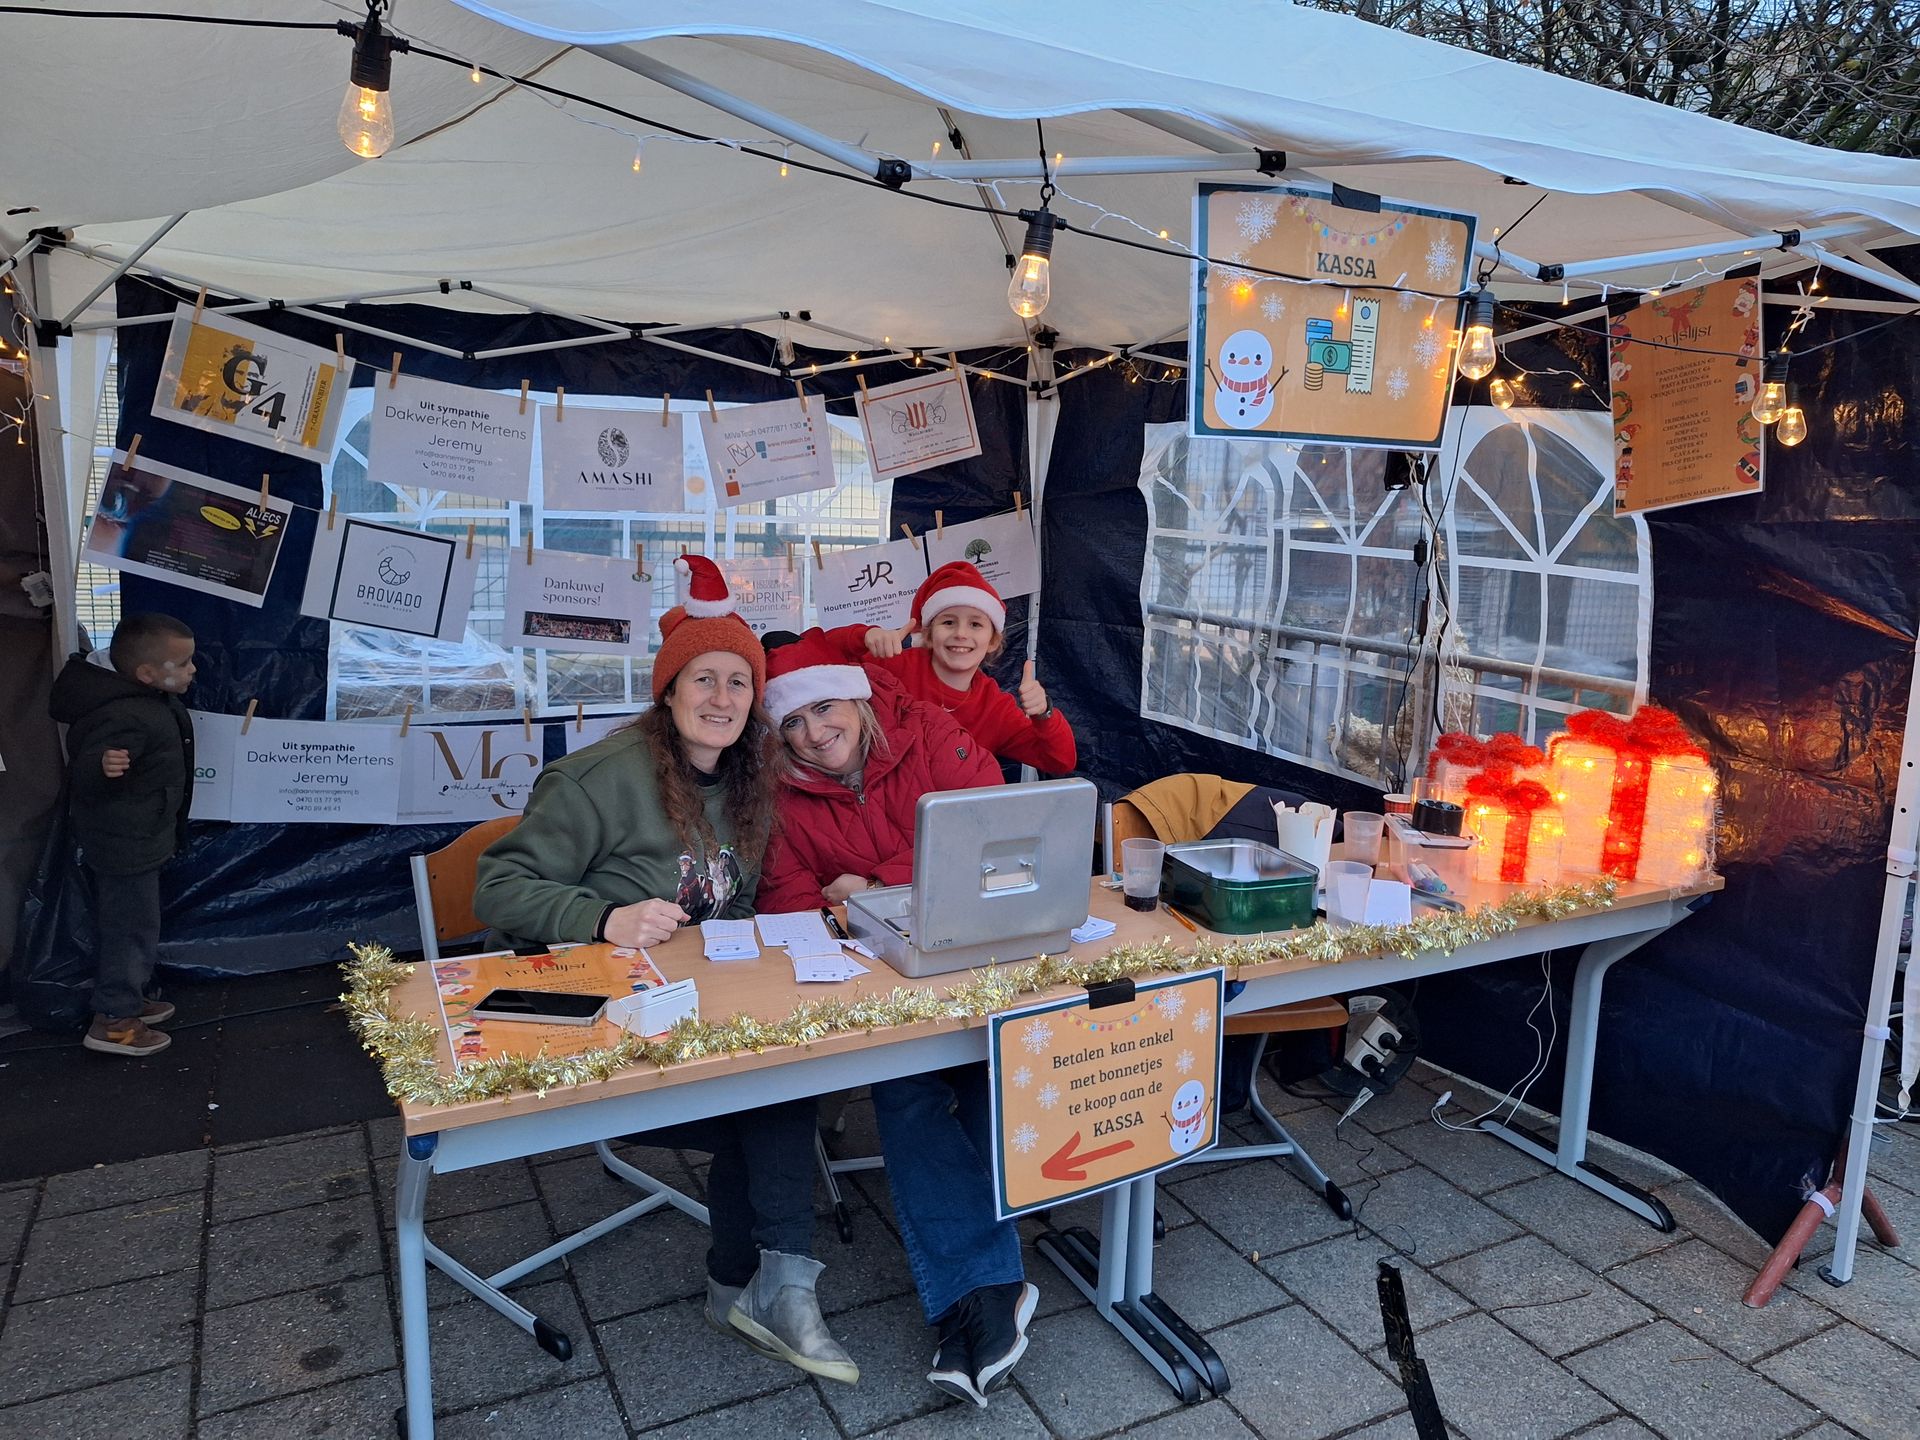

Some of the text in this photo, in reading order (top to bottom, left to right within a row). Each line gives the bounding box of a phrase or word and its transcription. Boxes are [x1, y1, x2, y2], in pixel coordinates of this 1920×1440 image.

[1316, 252, 1377, 279] KASSA
[1652, 324, 1712, 350] Prijslijst
[420, 401, 490, 420] Uit sympathie
[385, 405, 527, 440] Dakwerken Mertens
[428, 434, 483, 455] Jeremy
[578, 470, 652, 486] AMASHI
[245, 507, 282, 525] ALTECS
[544, 577, 604, 593] Dankuwel
[356, 584, 422, 608] BROVADO
[542, 592, 601, 606] sponsors!
[823, 601, 852, 613] Houten
[853, 595, 882, 610] trappen
[882, 592, 898, 602] Van
[282, 741, 356, 753] Uit sympathie
[247, 750, 395, 766] Dakwerken Mertens
[292, 771, 349, 786] Jeremy
[1052, 1028, 1174, 1070] Betalen kan enkel
[1069, 1057, 1163, 1091] met bonnetjes
[1068, 1080, 1163, 1116] te koop aan de
[1093, 1110, 1145, 1138] KASSA
